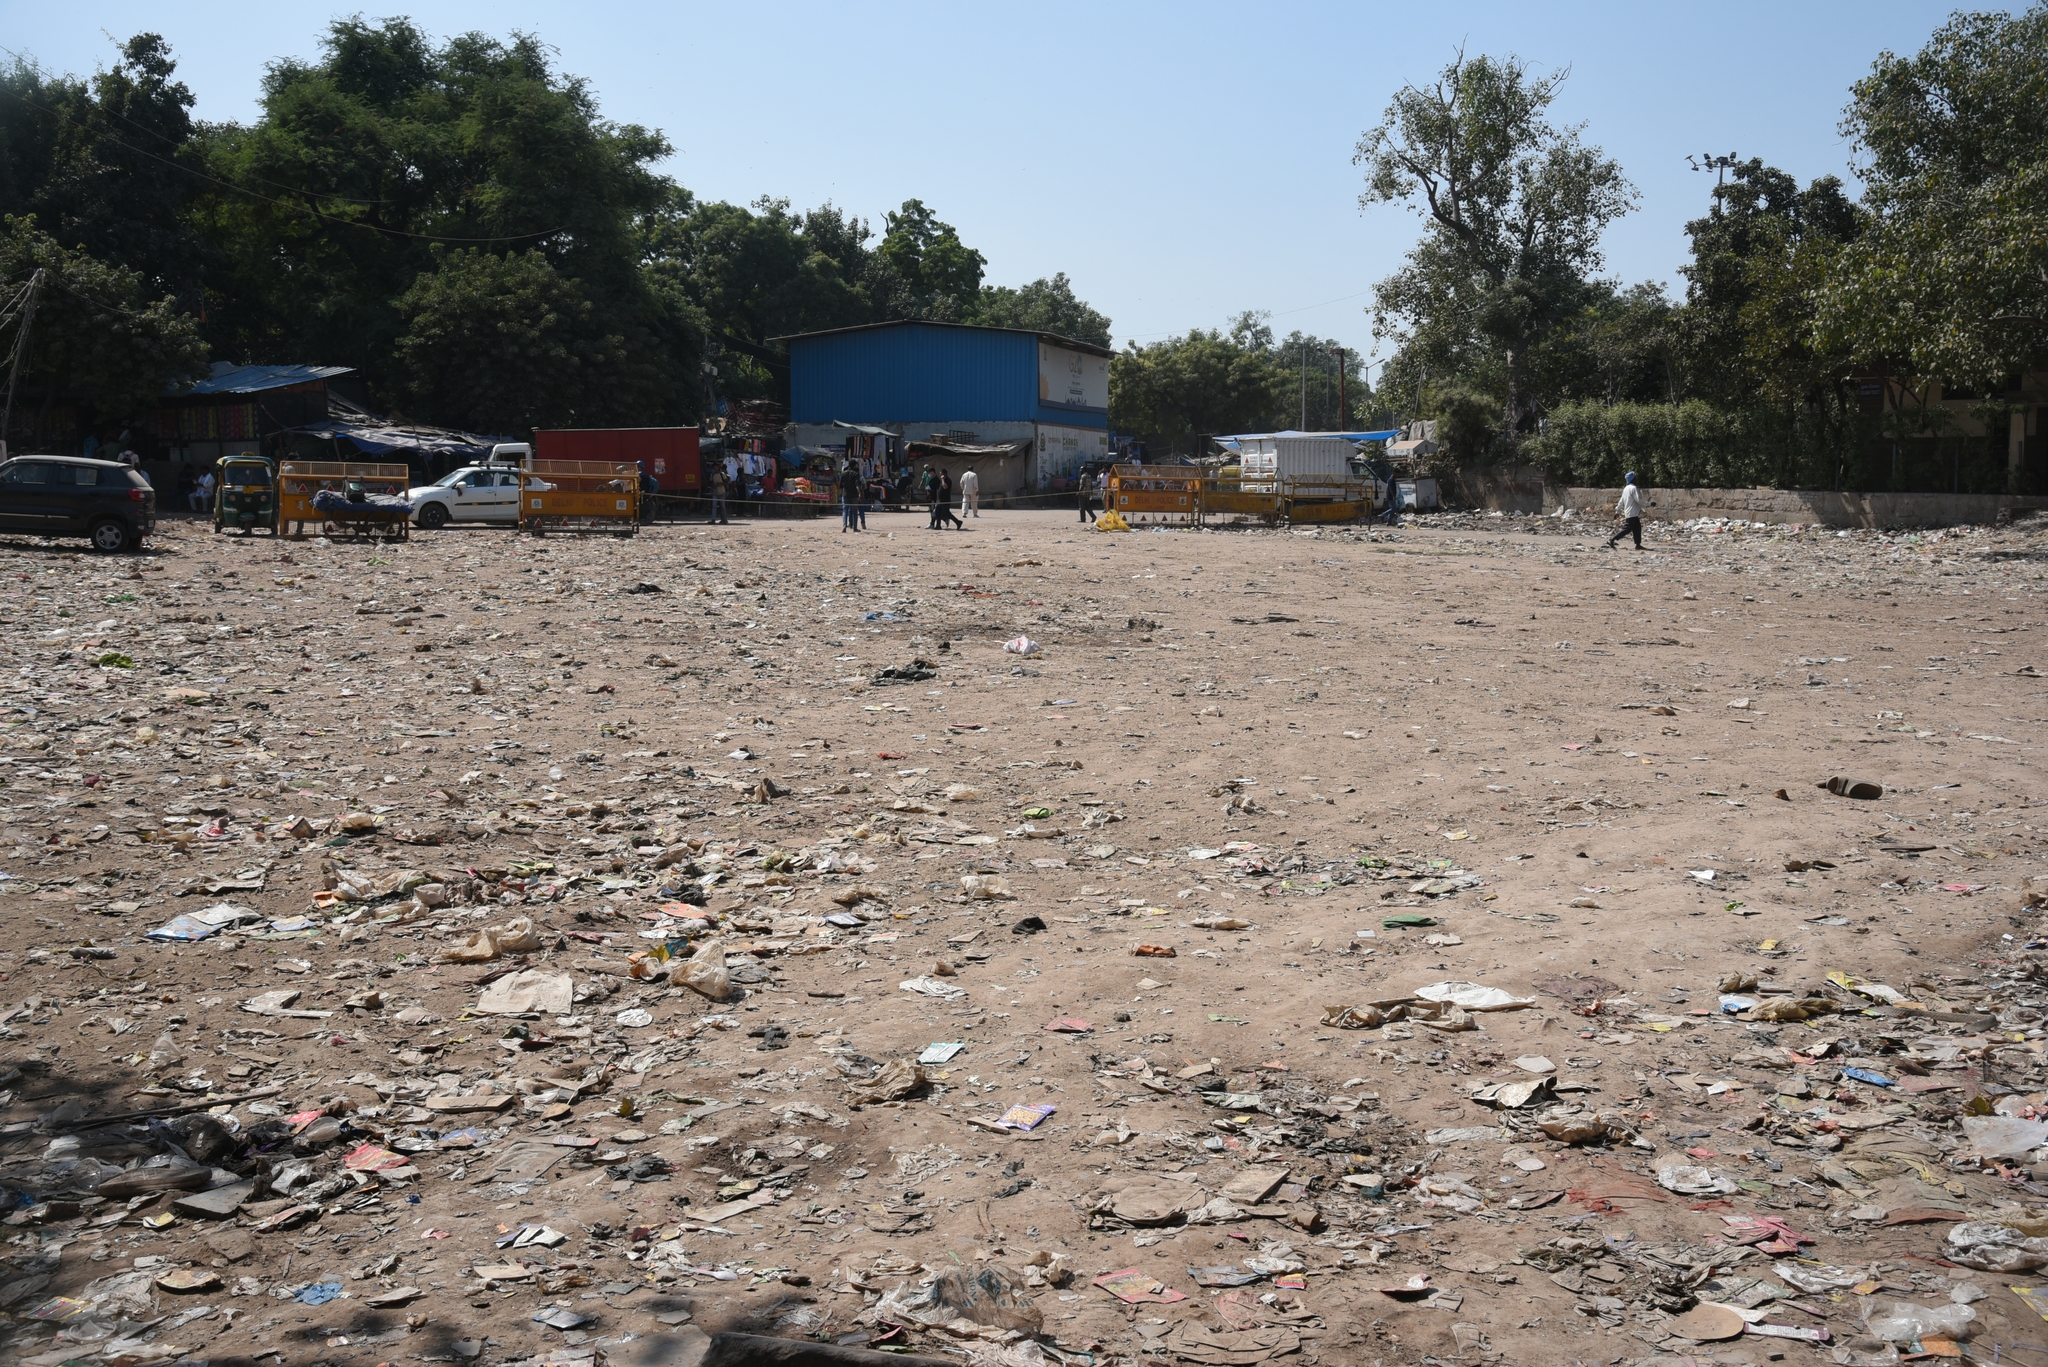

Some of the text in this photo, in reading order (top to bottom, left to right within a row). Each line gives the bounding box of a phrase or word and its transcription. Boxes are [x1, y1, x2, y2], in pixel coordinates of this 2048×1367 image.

[553, 498, 608, 507] DELHI POLICE
[1135, 496, 1174, 504] DELHI POLICE
[1302, 506, 1347, 516] DELHI POLICE
